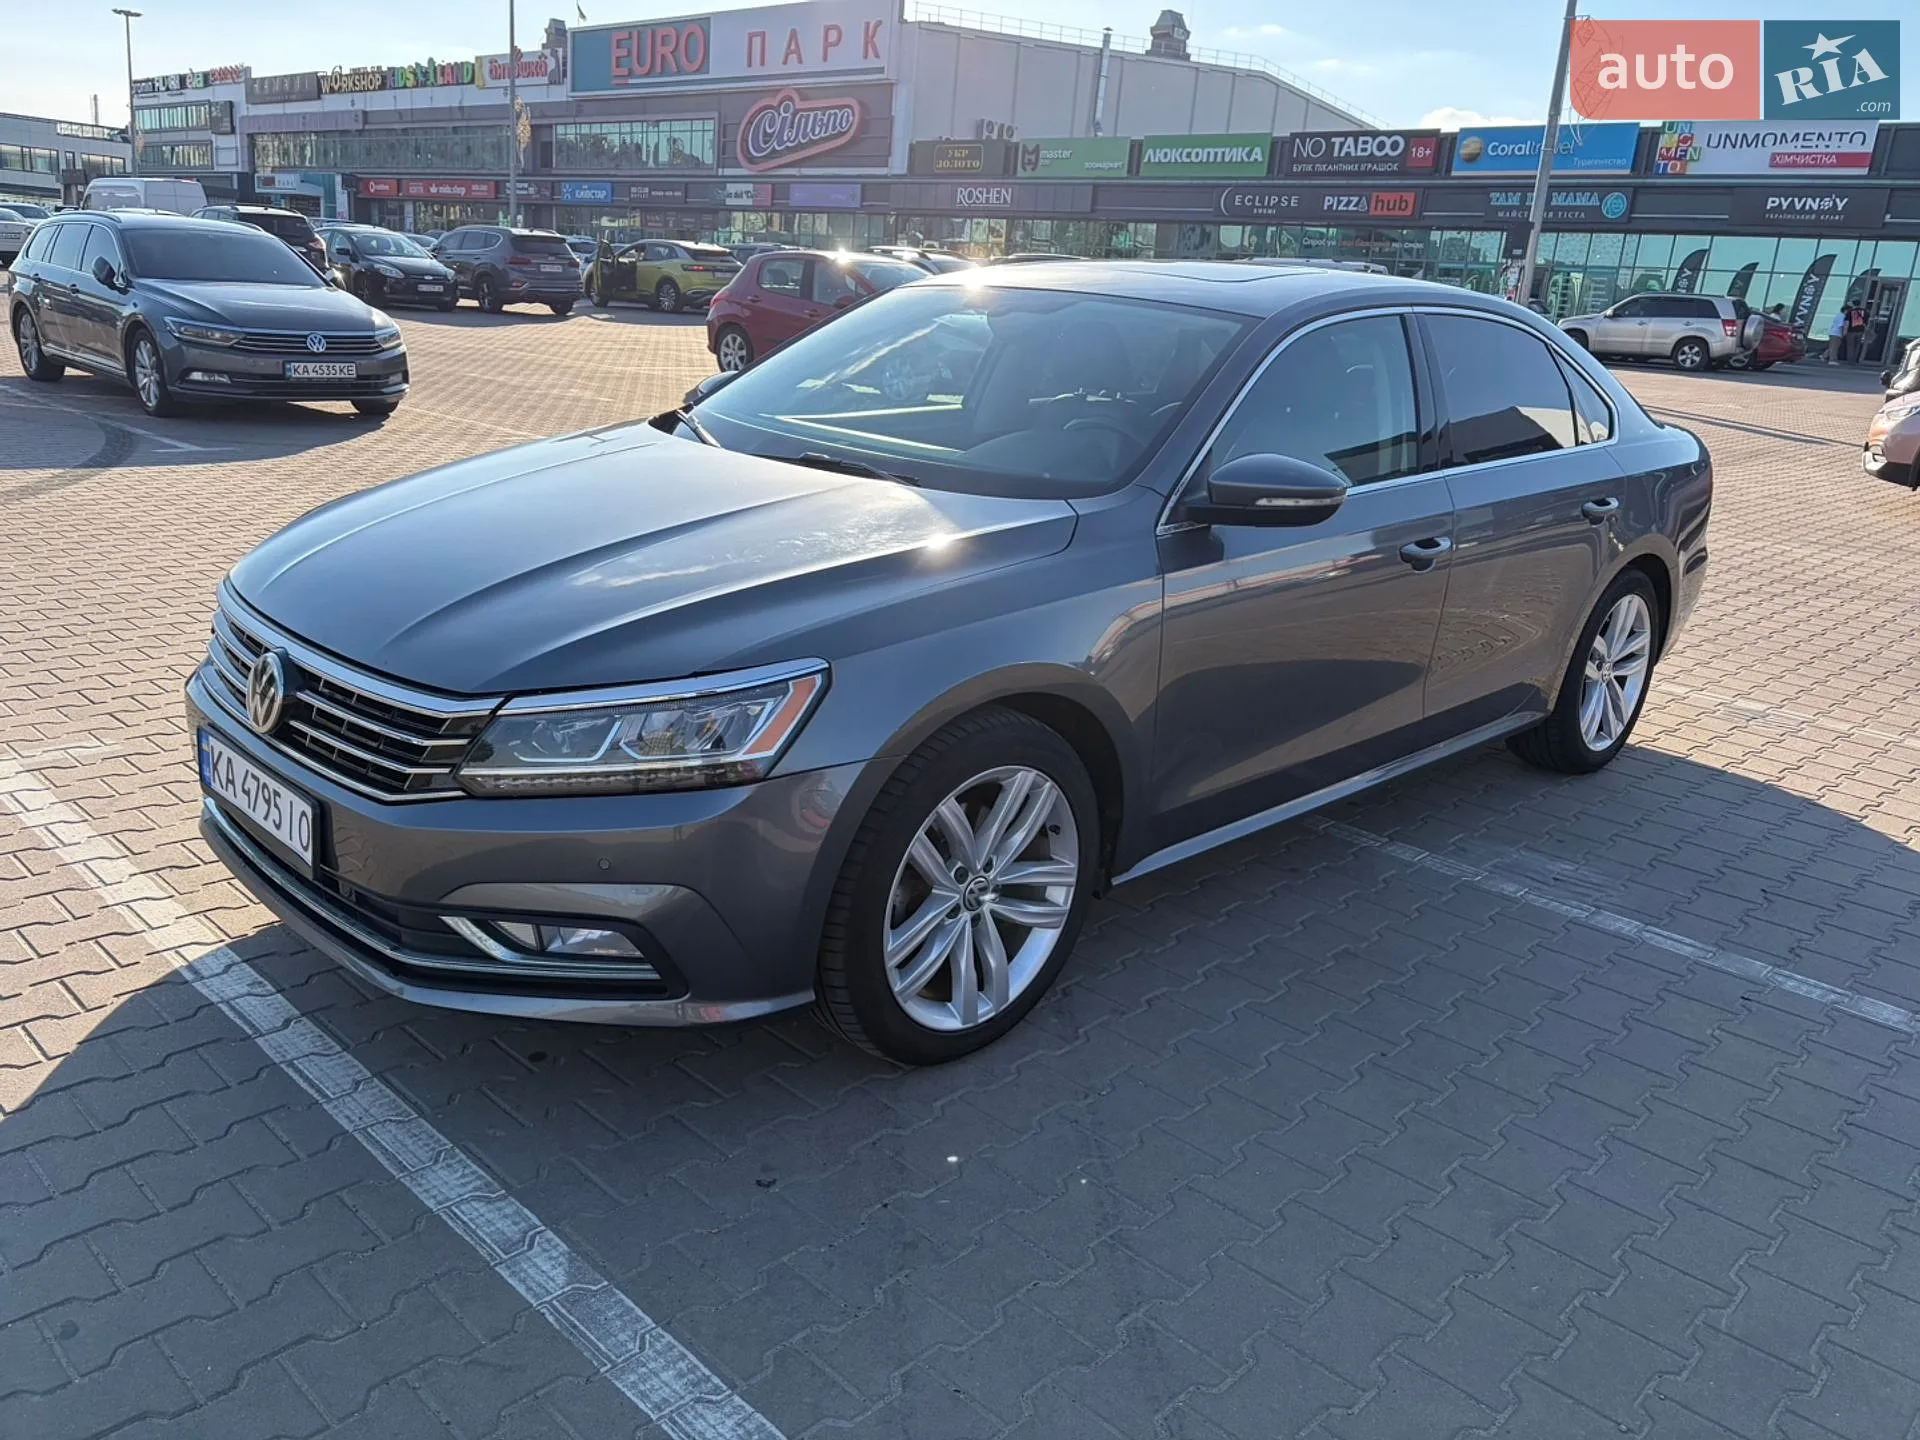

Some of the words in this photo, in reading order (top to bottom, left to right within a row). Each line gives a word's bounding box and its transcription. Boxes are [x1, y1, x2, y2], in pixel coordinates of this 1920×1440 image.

[611, 22, 707, 78] EURO
[747, 19, 883, 68] ПАРК
[321, 69, 382, 94] WORKSHOP
[749, 100, 854, 157] Сільпо
[1293, 137, 1326, 158] NO
[1331, 135, 1406, 157] TABOO
[1411, 147, 1432, 158] 18+
[1706, 131, 1867, 149] UNMOMENTO
[1039, 148, 1072, 160] master
[1144, 146, 1263, 163] ЛЮКСОПТИКА
[1773, 153, 1837, 165] ХІМЧИСТКА
[956, 187, 1012, 205] ROSHEN
[1234, 194, 1300, 207] ECLIPSE
[1374, 193, 1409, 212] hub
[291, 364, 309, 377] KA
[311, 364, 337, 376] 4535
[338, 364, 355, 377] KE
[212, 750, 237, 798] KA
[241, 768, 283, 831] 4795
